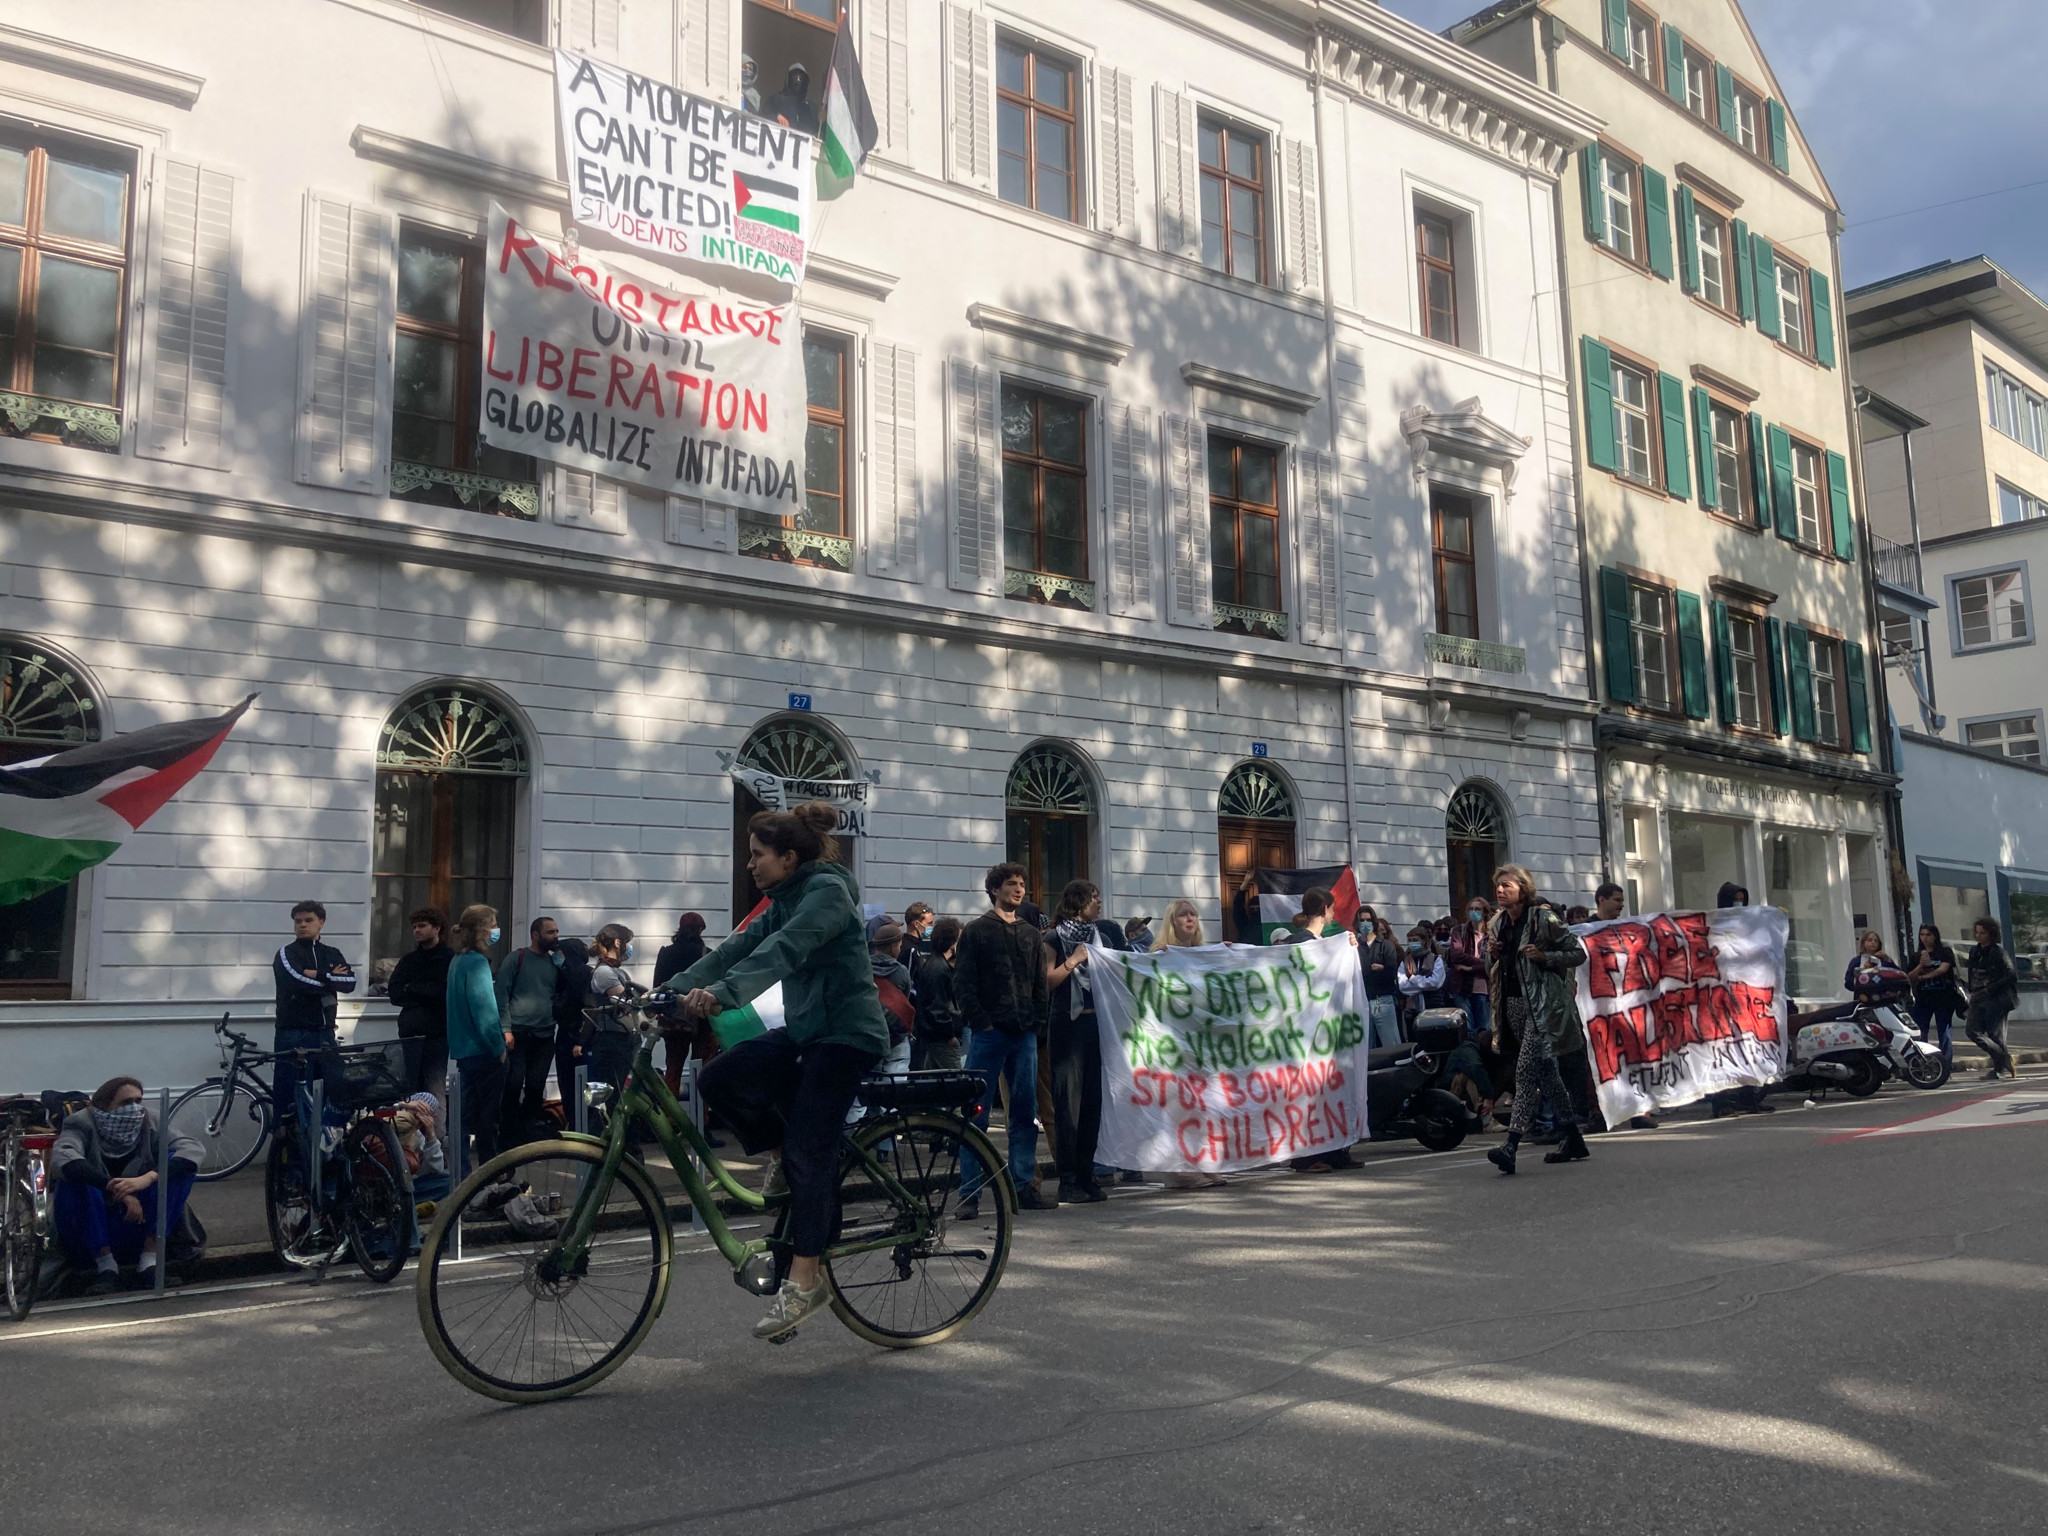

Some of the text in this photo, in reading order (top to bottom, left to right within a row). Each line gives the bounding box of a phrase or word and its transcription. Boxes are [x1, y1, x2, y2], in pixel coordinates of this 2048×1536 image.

[569, 59, 809, 170] A MOVEMENT
[575, 106, 727, 188] CAN'T BE
[577, 158, 732, 235] EVICTED!
[580, 197, 797, 282] STUDENTS INTIFADA
[499, 217, 785, 345] RESISTANCE
[591, 306, 716, 372] UNTIL
[486, 330, 768, 432] LIBERATION
[485, 388, 798, 504] GLOBALIZE INTIFADA
[792, 696, 808, 708] 27
[1254, 745, 1266, 755] 29
[1705, 780, 1803, 807] GALERIE DURCHGANG
[1121, 955, 1194, 1023] We
[1582, 912, 1721, 999] FREE
[1185, 1014, 1306, 1071] violent
[1312, 1011, 1365, 1056] ones
[1130, 1058, 1346, 1112] STOP BOMBING
